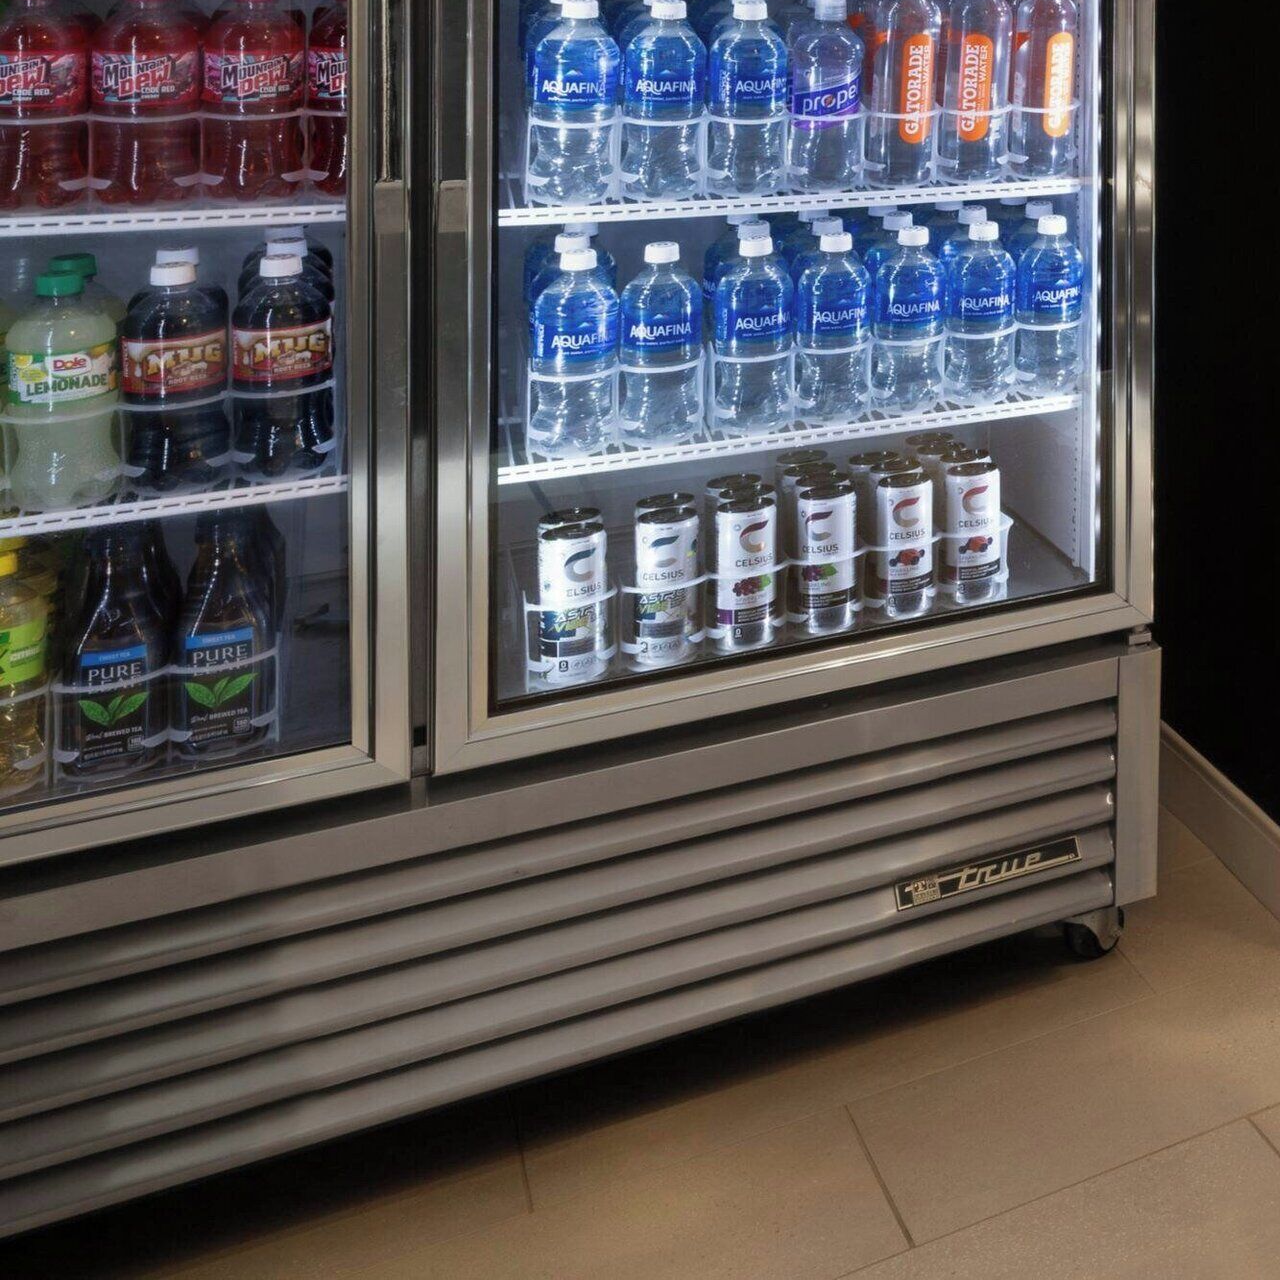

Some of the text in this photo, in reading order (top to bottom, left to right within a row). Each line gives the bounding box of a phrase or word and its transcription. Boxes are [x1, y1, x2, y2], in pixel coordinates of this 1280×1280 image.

[103, 57, 168, 88] MOUNTAIN
[222, 57, 283, 88] MOUNTAIN
[542, 78, 607, 96] AQUAFINA
[636, 78, 697, 96] AQUAFINA
[905, 45, 923, 135] GATORADE
[961, 44, 981, 132] GATORADE
[802, 81, 857, 114] prope
[887, 299, 940, 318] AQUAFINA
[959, 294, 1010, 311] AQUAFINA
[630, 322, 691, 340] AQUAFINA
[254, 334, 326, 362] MUG
[147, 343, 222, 376] MUG
[26, 374, 107, 396] LEMONADE
[890, 528, 926, 541] CELSIUS
[802, 543, 839, 555] CELSIUS
[735, 552, 774, 568] CELSIUS
[643, 570, 684, 581] CELSIUS
[193, 644, 247, 664] PURE
[88, 662, 143, 681] PURE
